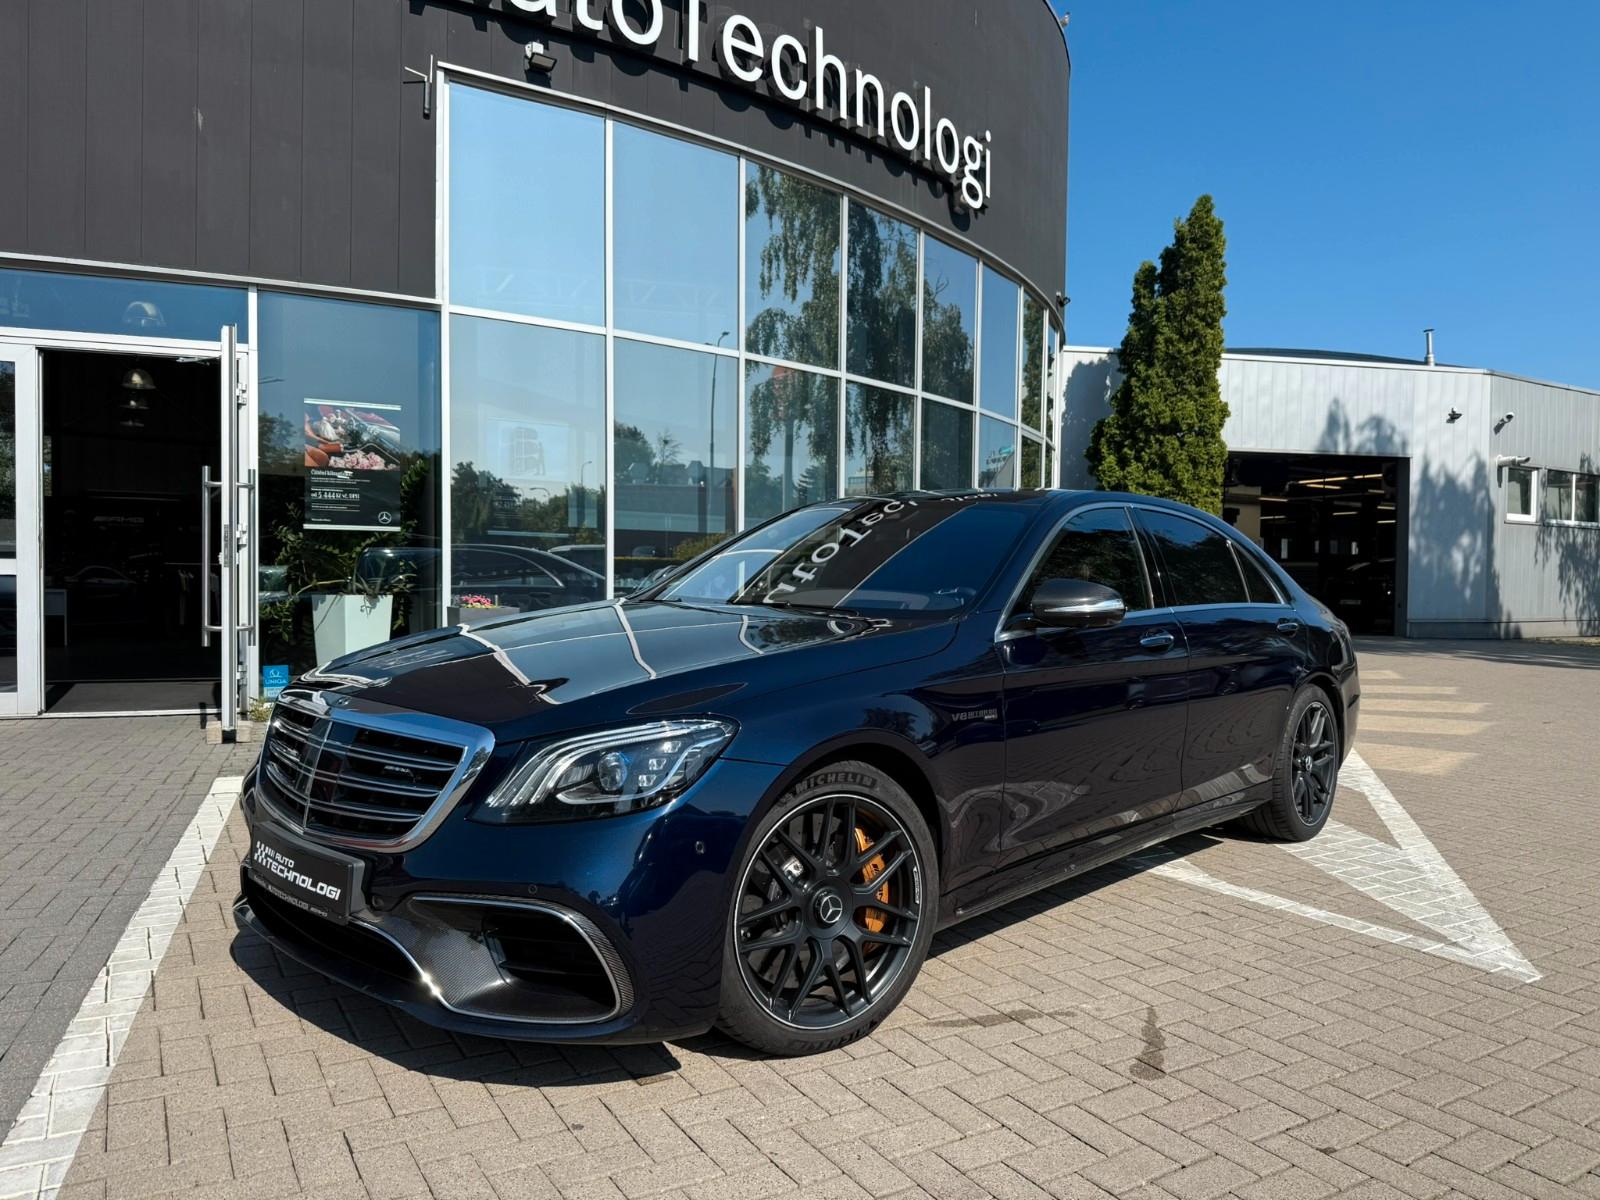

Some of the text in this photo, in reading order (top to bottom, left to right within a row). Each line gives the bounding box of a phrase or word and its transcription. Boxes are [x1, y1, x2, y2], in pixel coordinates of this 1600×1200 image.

[795, 773, 873, 793] MICHELIN
[275, 852, 295, 868] AUTO
[266, 857, 341, 900] TECHNOLOGI
